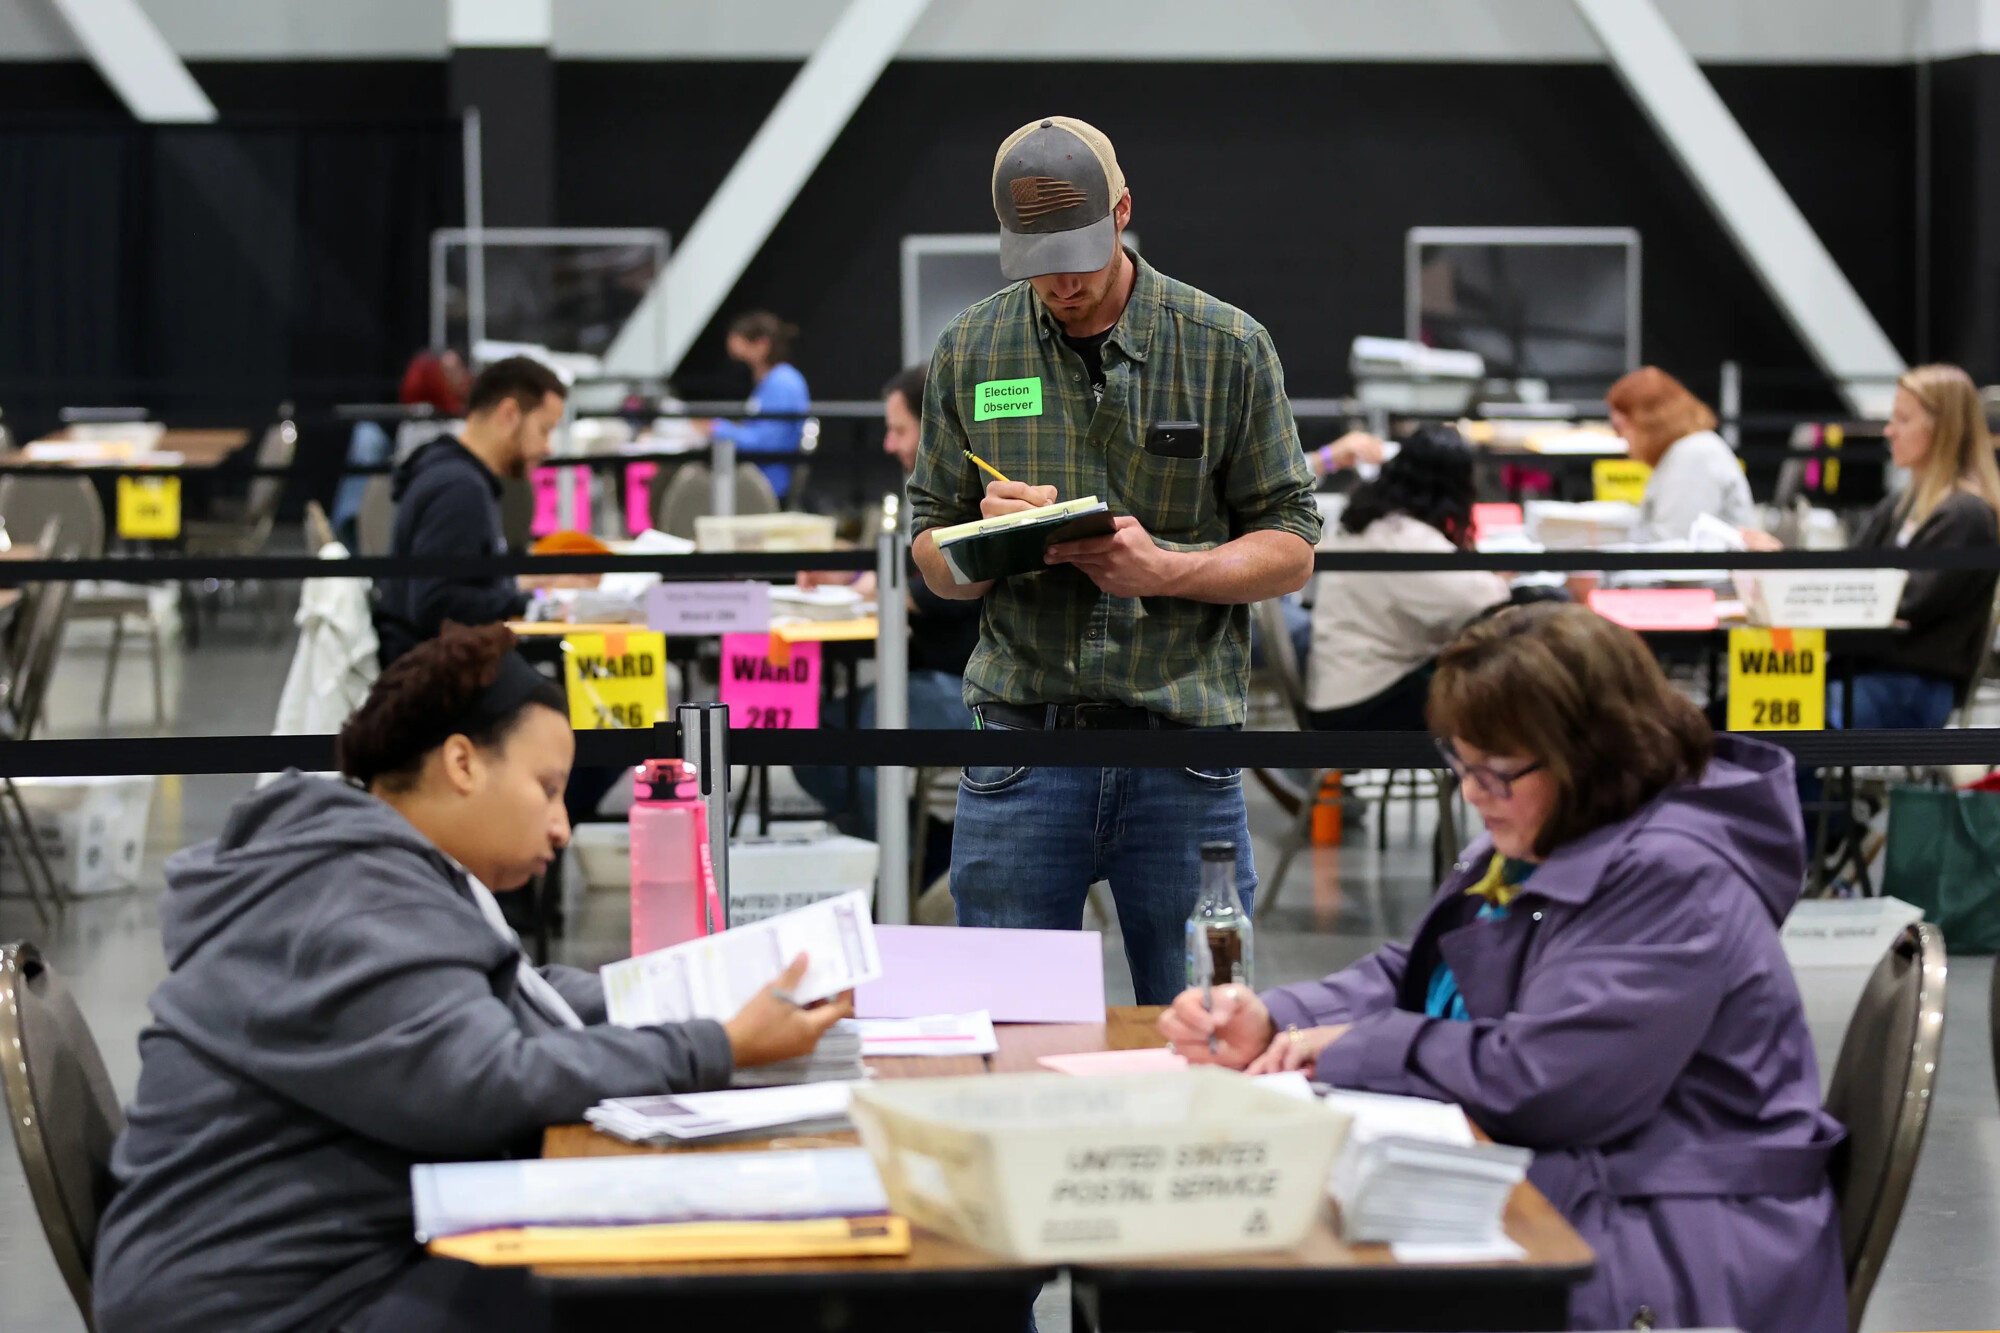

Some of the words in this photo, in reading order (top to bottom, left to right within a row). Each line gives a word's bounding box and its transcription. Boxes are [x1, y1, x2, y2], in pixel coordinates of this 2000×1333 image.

[984, 385, 1030, 398] Election
[983, 400, 1034, 413] Observer
[1739, 649, 1815, 675] WARD
[746, 706, 792, 728] 287
[1752, 699, 1801, 725] 288
[731, 893, 779, 908] NITED
[1066, 1145, 1164, 1172] UNITED
[1177, 1141, 1267, 1166] STATES
[1051, 1177, 1153, 1204] POSTAL
[1170, 1171, 1280, 1201] SERVICE
